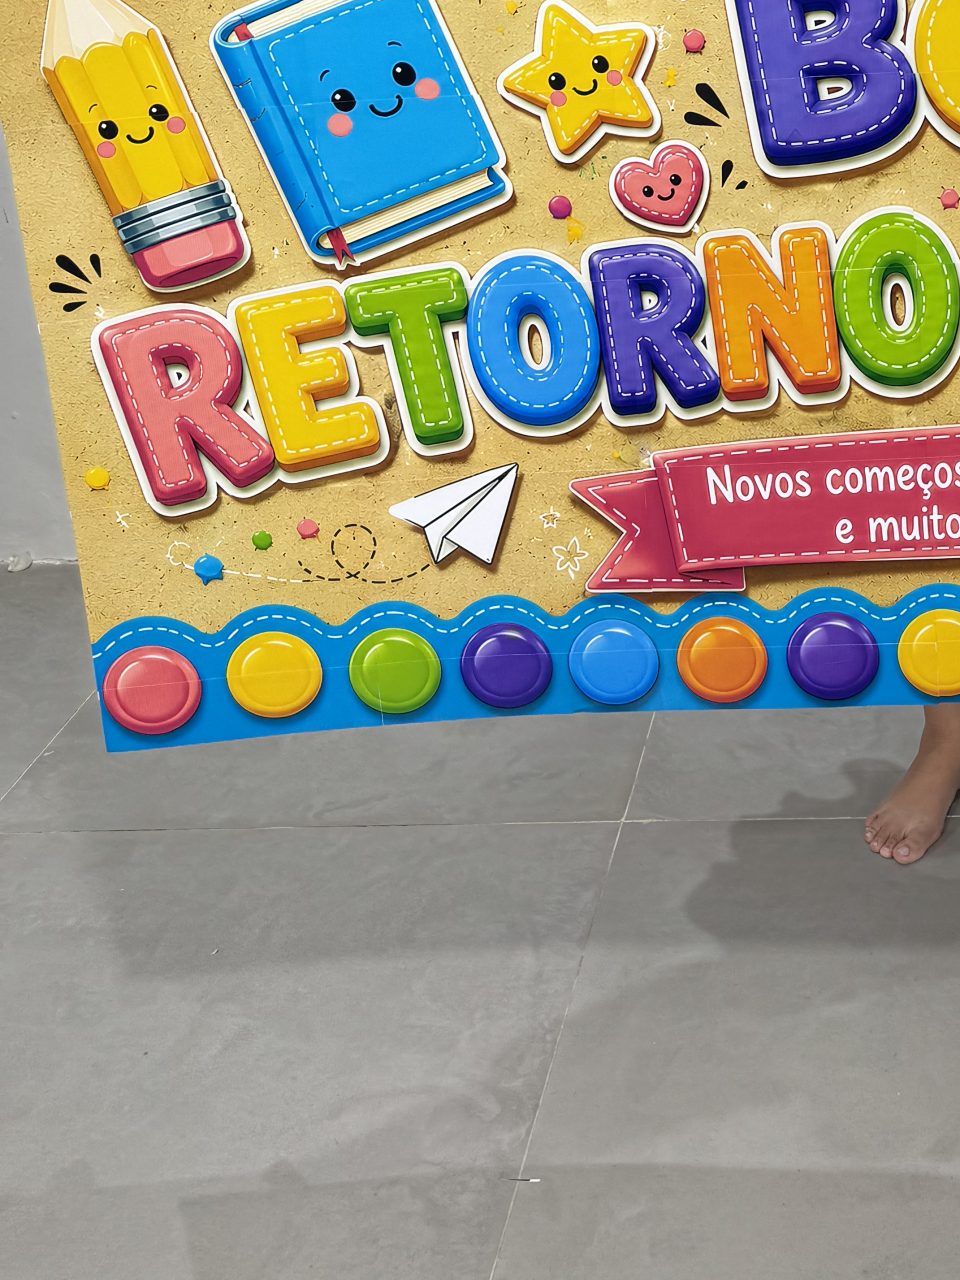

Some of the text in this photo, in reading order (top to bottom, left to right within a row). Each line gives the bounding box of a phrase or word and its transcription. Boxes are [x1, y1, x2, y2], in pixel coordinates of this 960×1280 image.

[97, 209, 960, 508] RETORNO
[706, 464, 812, 505] Novos
[835, 518, 855, 544] e
